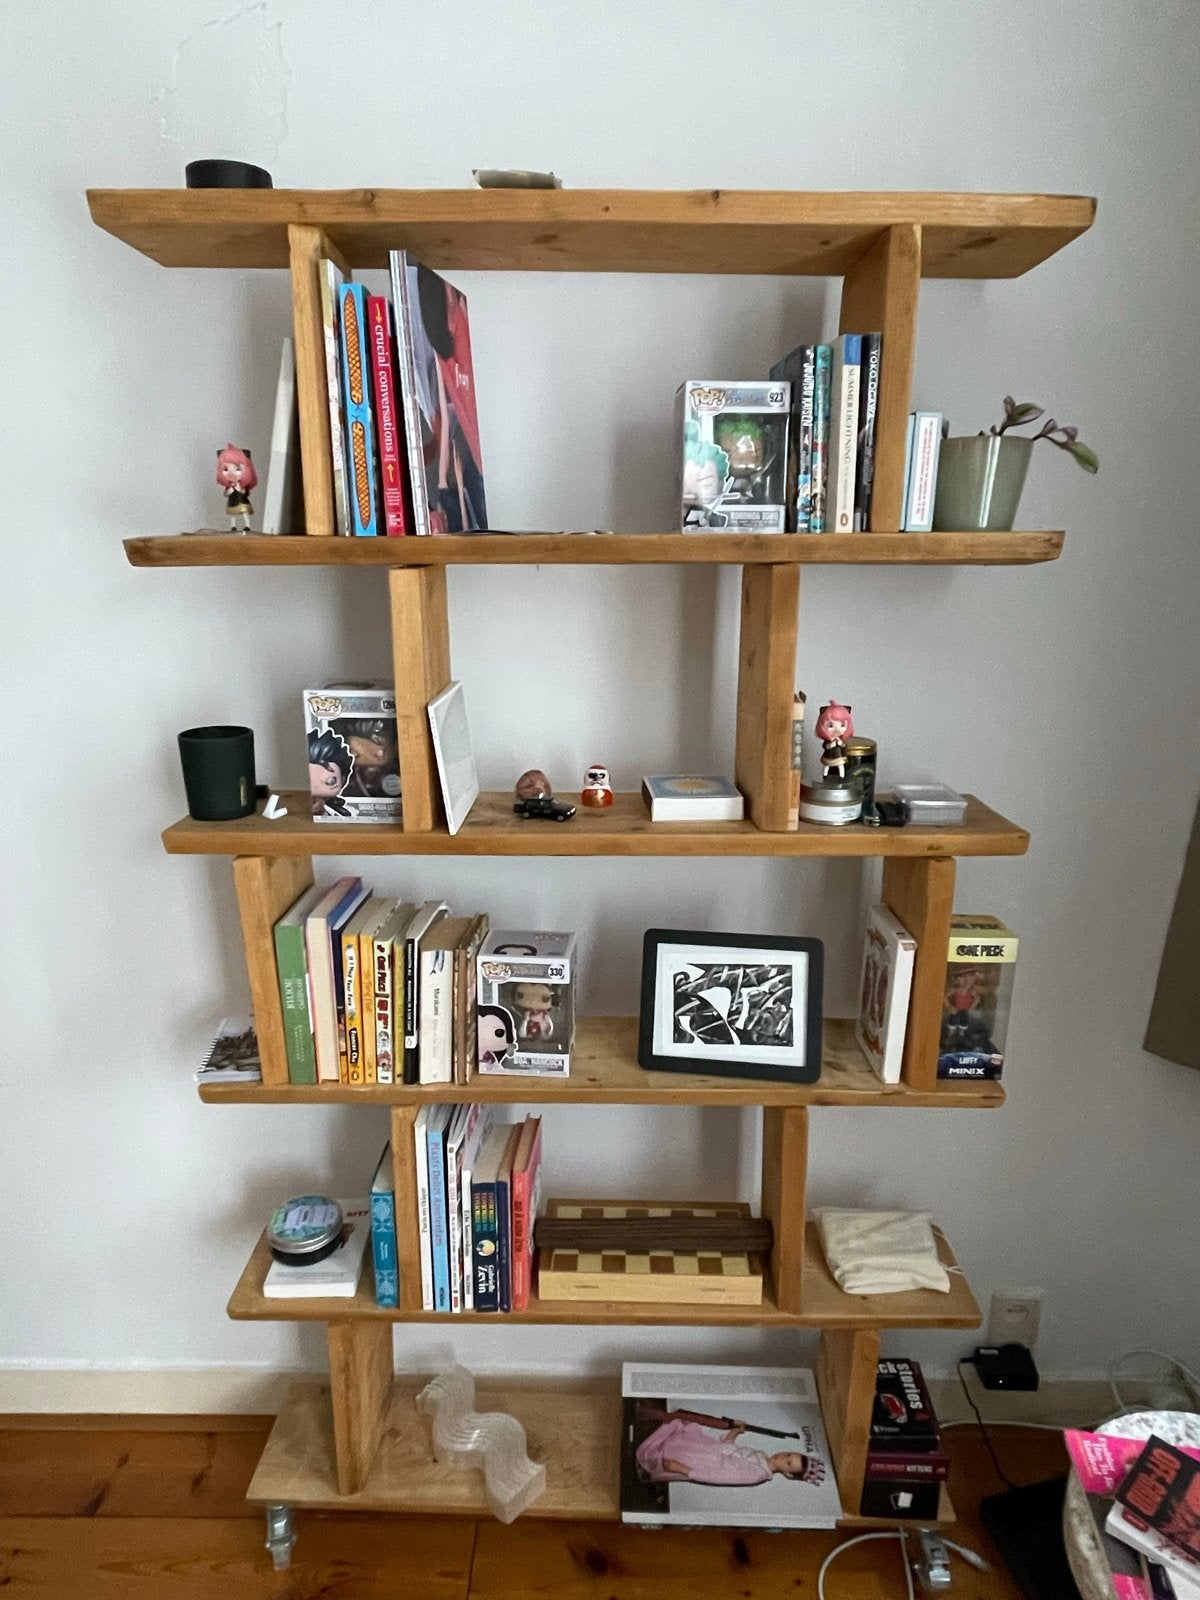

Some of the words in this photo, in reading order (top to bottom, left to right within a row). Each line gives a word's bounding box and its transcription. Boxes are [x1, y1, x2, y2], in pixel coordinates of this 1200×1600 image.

[375, 325, 390, 367] crucial
[869, 350, 880, 380] YOKO
[803, 362, 815, 395] JUJUTSU
[845, 368, 855, 411] SUMMER
[692, 387, 724, 406] POP!
[769, 392, 785, 402] 923
[379, 371, 394, 452] conversations
[801, 398, 813, 427] KAISEN
[308, 696, 341, 710] POP!
[956, 944, 980, 957] ONE
[980, 944, 1005, 957] PIECE
[481, 961, 511, 976] POP!
[550, 967, 563, 977] 330
[949, 1067, 985, 1076] MINIX
[959, 1057, 978, 1065] LUFFY
[431, 1142, 440, 1167] Plaats
[434, 1197, 444, 1247] Amsterdam
[477, 1265, 488, 1293] Zevin
[487, 1264, 496, 1292] Gabrielle
[896, 1363, 923, 1409] stories
[906, 1465, 933, 1474] KITTENS
